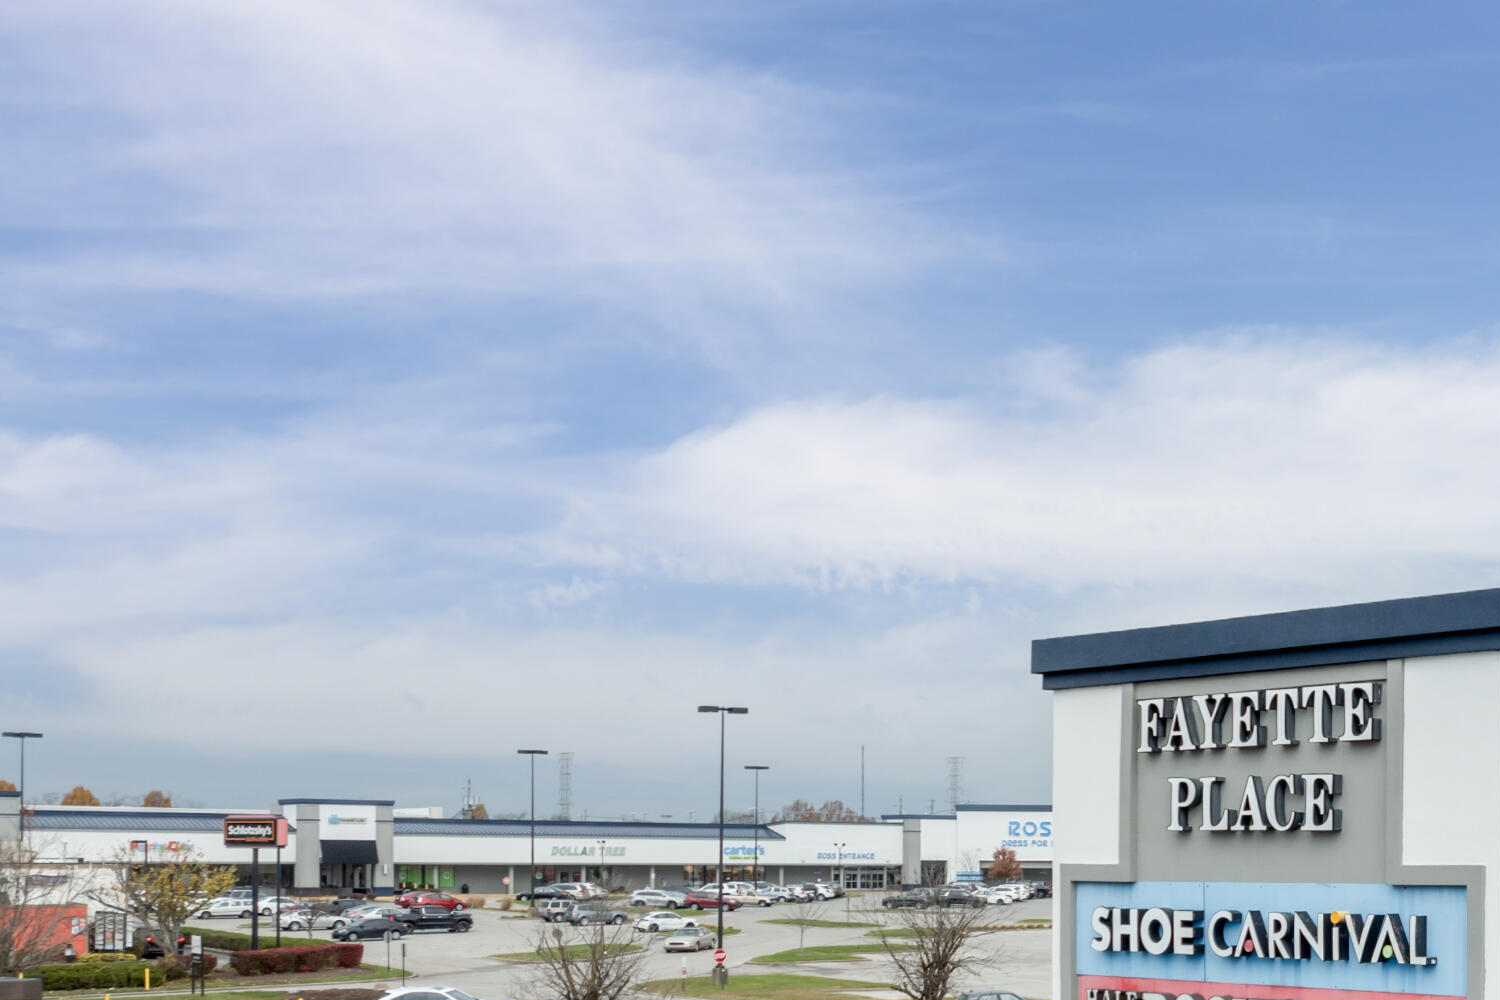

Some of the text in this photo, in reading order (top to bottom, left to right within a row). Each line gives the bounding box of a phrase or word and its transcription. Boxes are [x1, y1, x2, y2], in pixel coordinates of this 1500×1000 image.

[1137, 681, 1382, 753] FAYETTE
[1167, 773, 1342, 832] PLACE
[551, 846, 627, 856] DOLLAR TREE
[1008, 821, 1052, 837] ROS
[1090, 906, 1203, 955] SHOE
